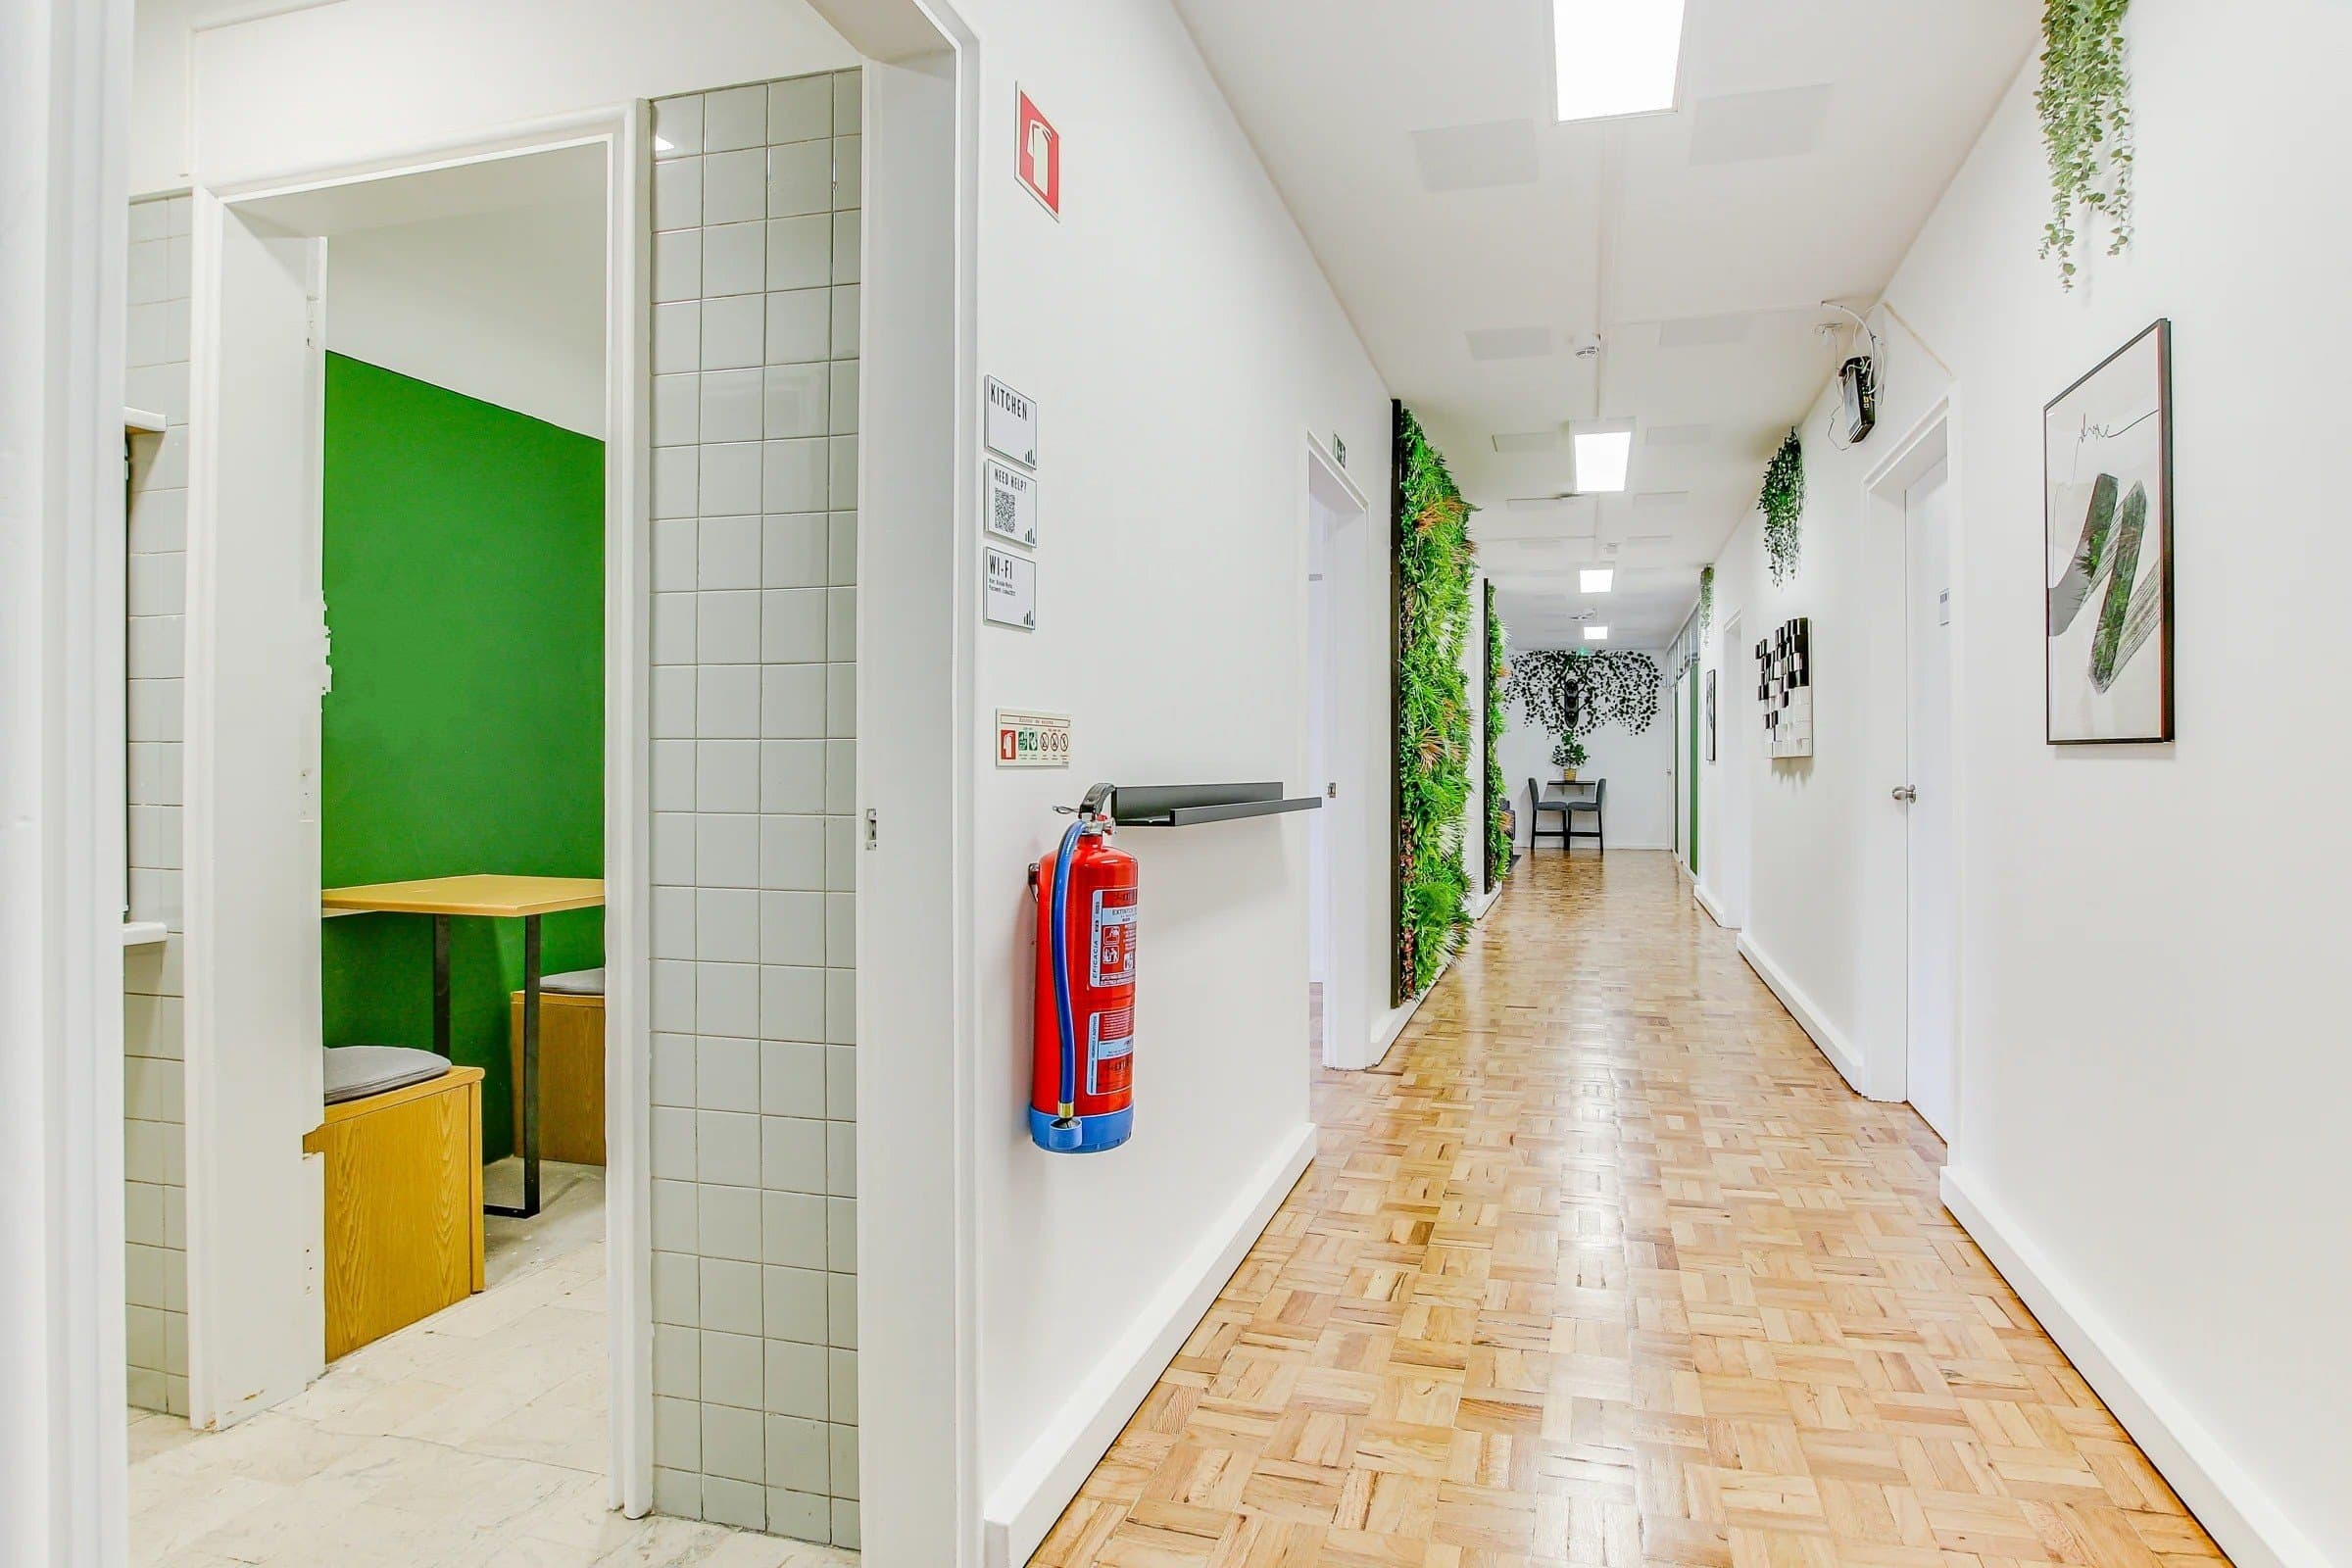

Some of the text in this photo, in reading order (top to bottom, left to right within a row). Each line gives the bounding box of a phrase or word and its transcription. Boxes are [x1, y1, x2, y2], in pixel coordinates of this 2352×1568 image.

[991, 383, 1027, 421] KITCHEN
[995, 467, 1027, 494] NEED HELP?
[989, 554, 1012, 580] WI-FI
